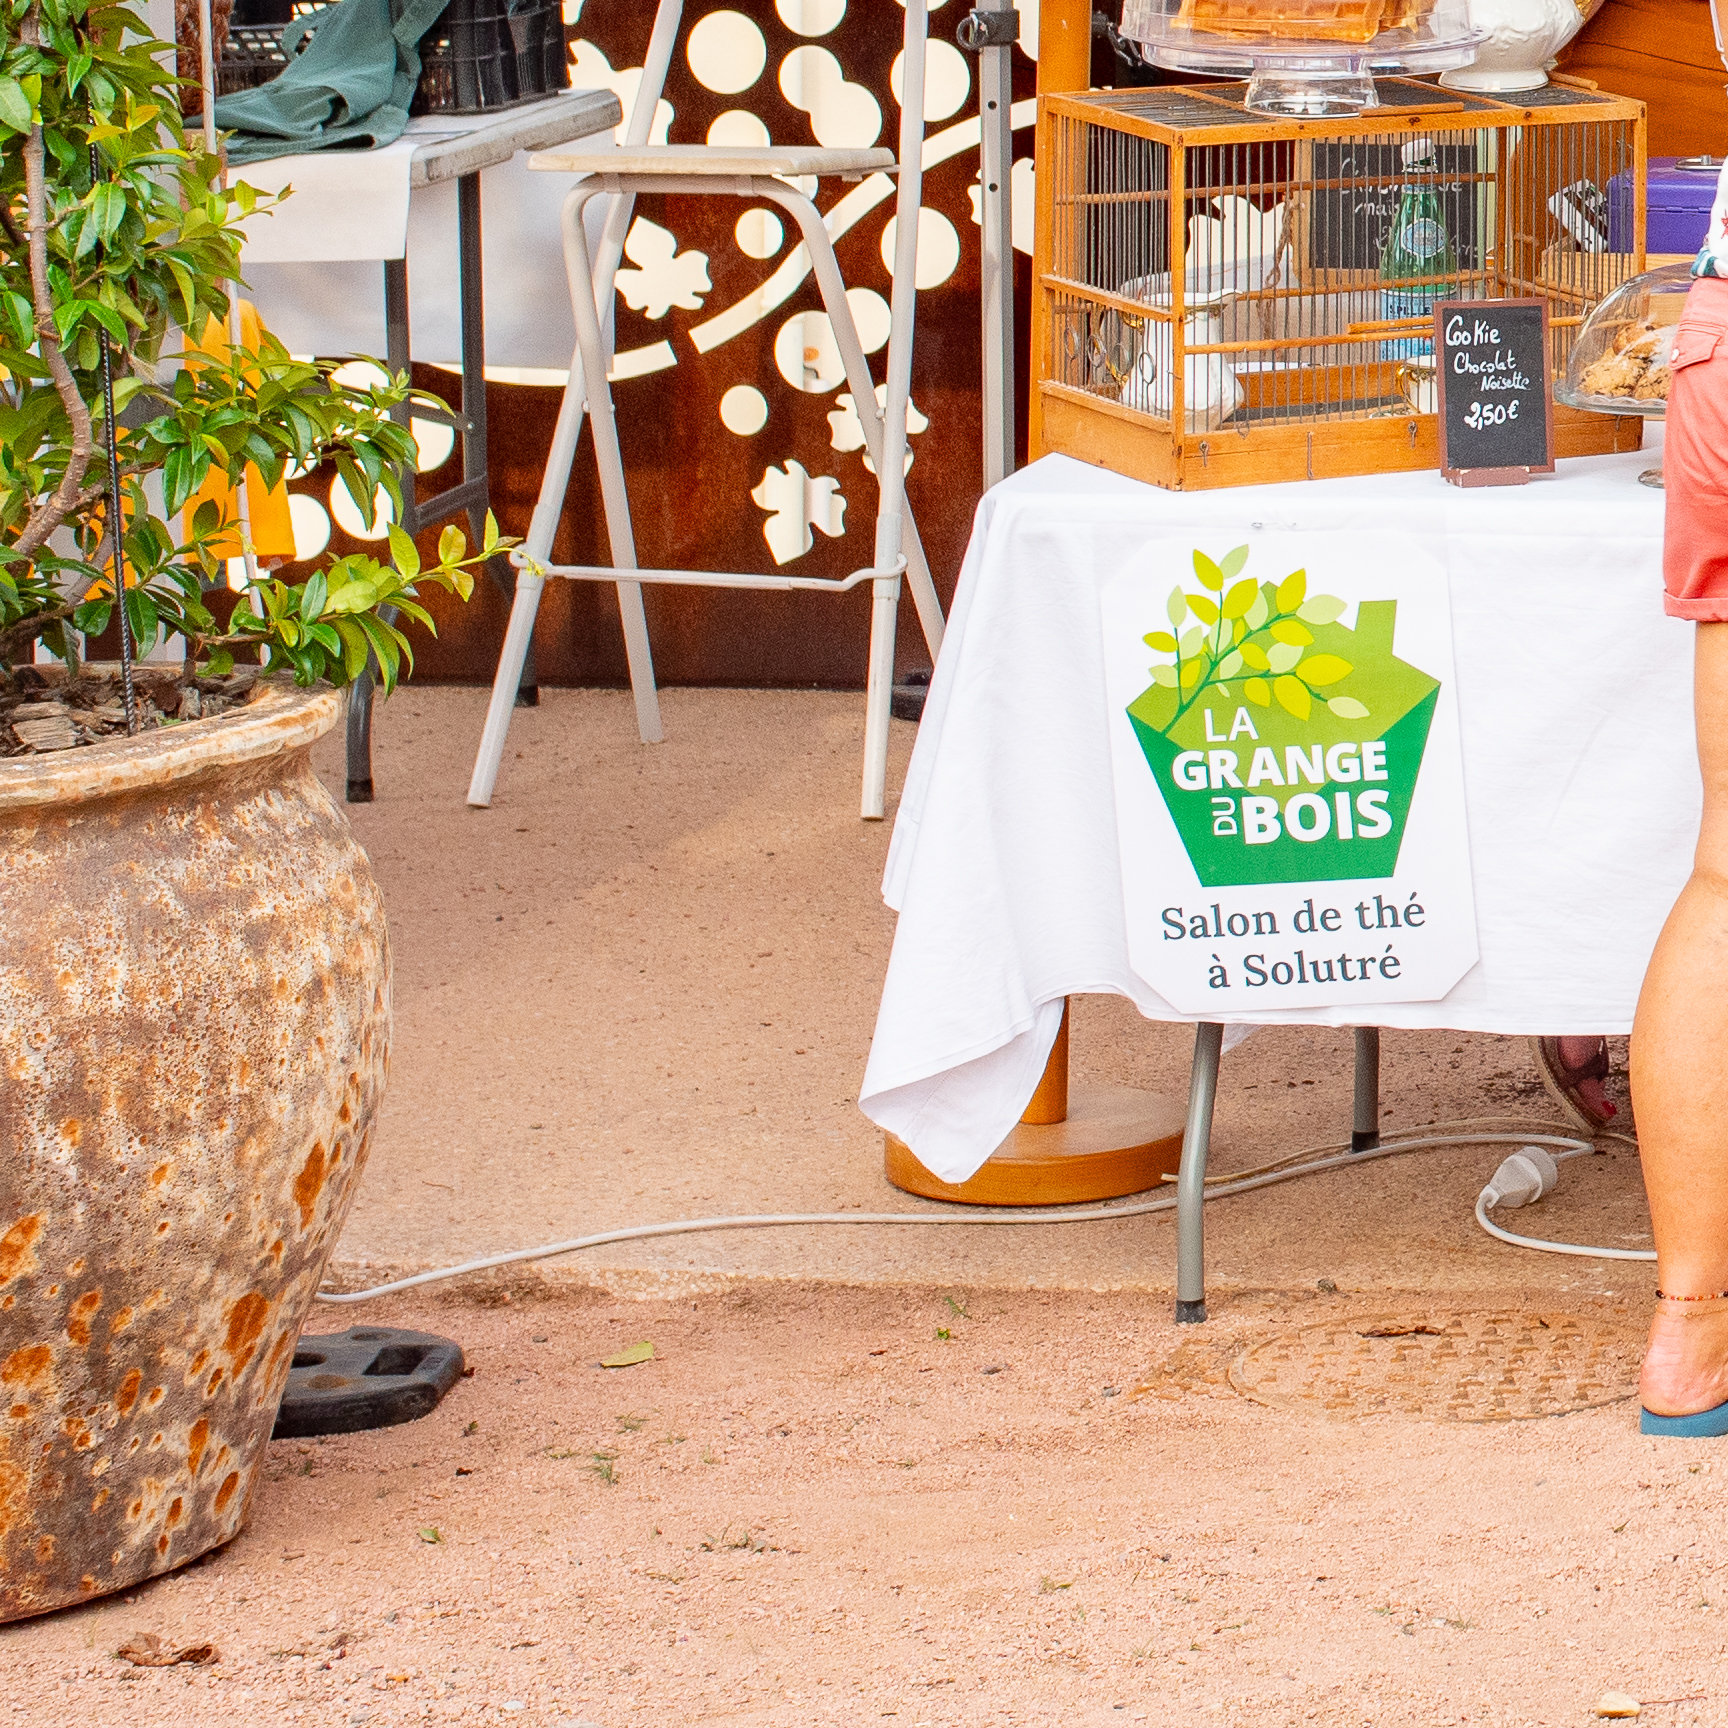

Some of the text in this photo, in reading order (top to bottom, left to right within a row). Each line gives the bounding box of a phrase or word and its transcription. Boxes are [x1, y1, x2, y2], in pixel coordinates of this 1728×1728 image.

[1446, 315, 1501, 346] Cookie
[1454, 349, 1516, 374] Chocolat
[1480, 371, 1531, 391] Noisette
[1464, 400, 1519, 430] 2,50€
[1204, 707, 1259, 743] LA
[1172, 741, 1389, 791] GRANGE
[1212, 790, 1393, 845] DU BOIS
[1161, 892, 1426, 942] Salon de thé
[1208, 944, 1402, 989] à Solutré
